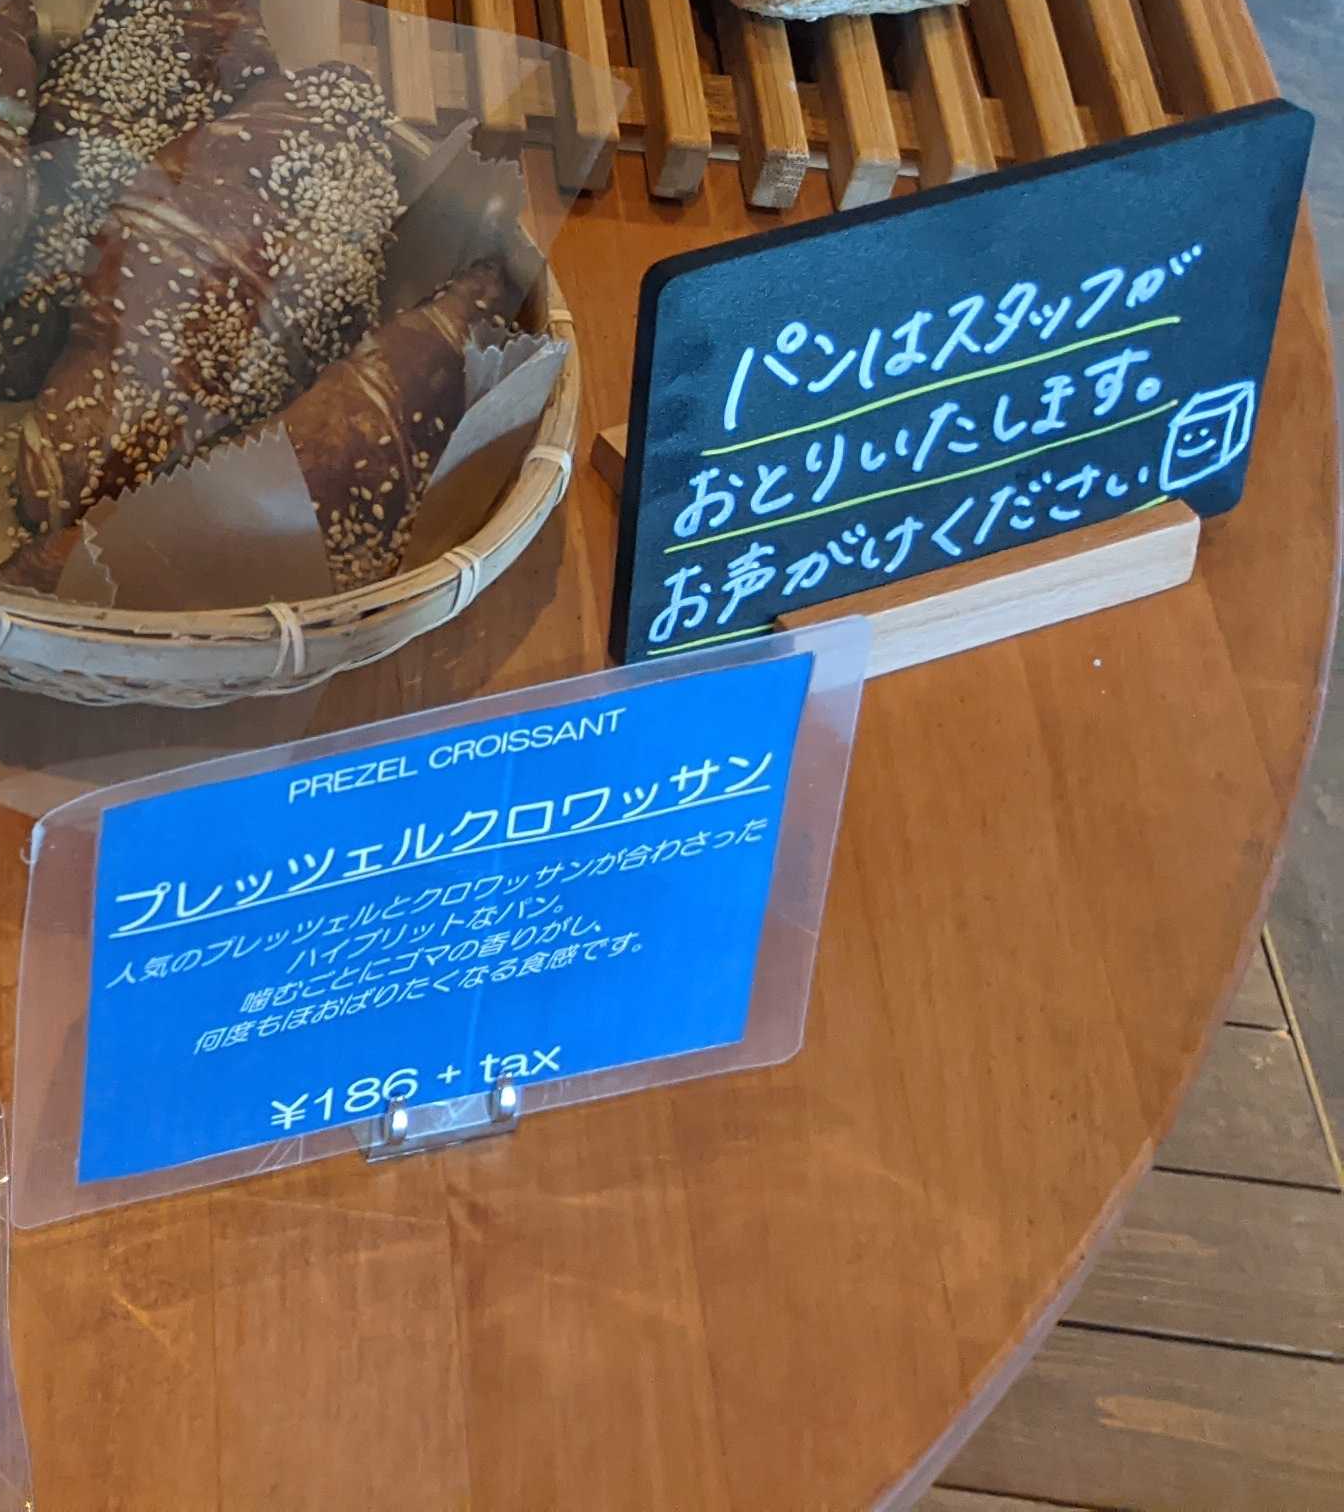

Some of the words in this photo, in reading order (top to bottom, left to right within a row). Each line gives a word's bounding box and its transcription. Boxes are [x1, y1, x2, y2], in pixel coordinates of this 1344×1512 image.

[722, 243, 1204, 432] パンはスタッフが
[674, 347, 1164, 538] おとりいたします。
[646, 462, 1152, 645] お声がけください
[113, 750, 775, 932] プレッツェルクロワッサン
[286, 746, 420, 804] PREZEL
[427, 707, 629, 770] CROISSANT
[269, 1066, 420, 1133] ¥186
[478, 1043, 565, 1084] tax
